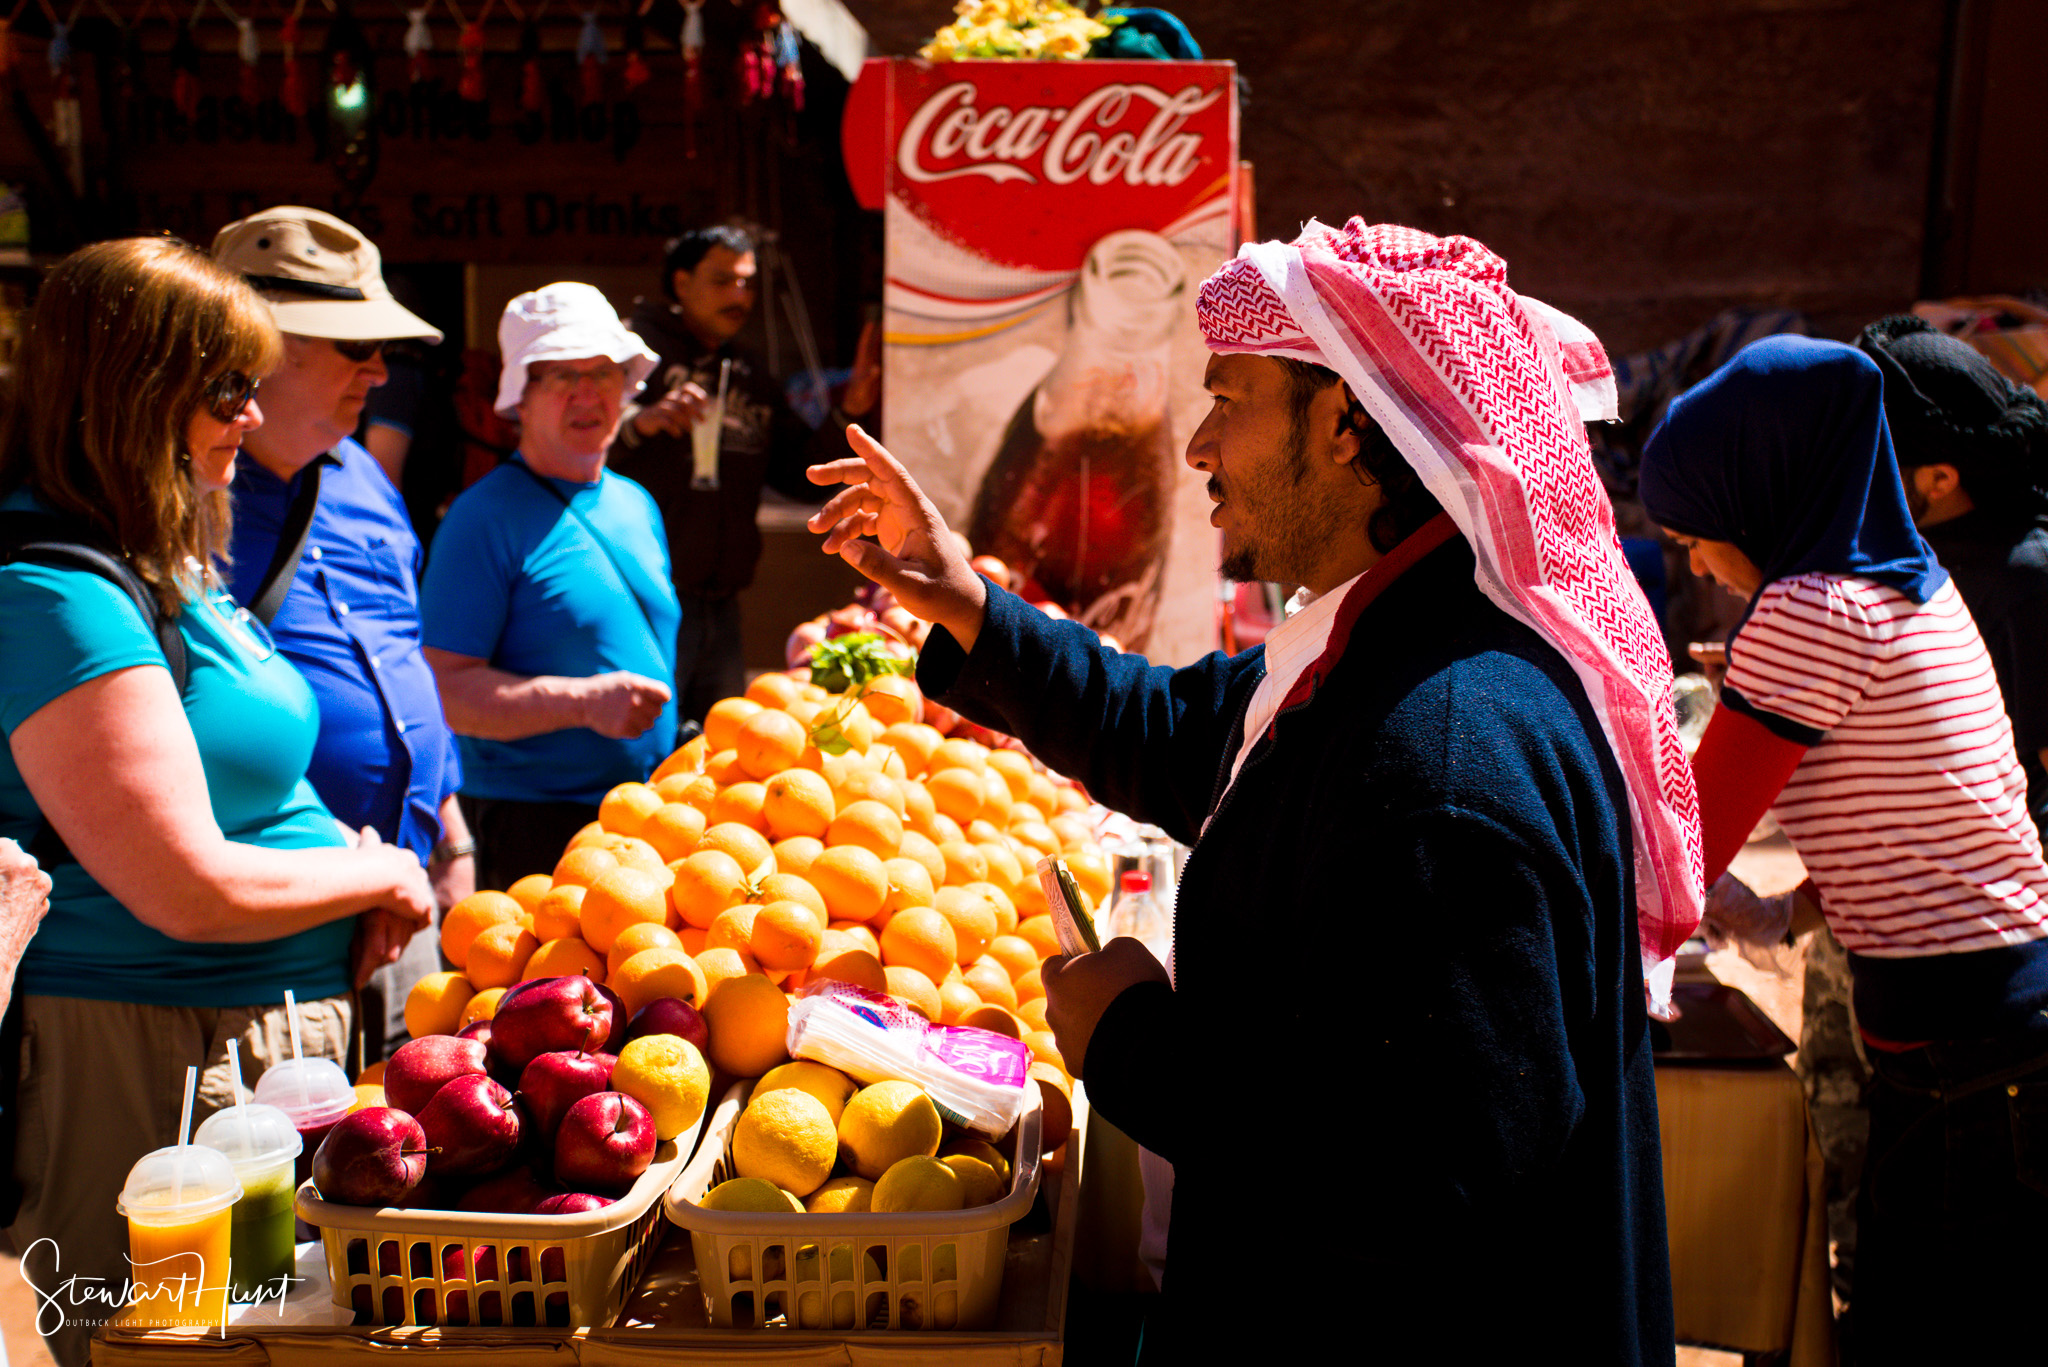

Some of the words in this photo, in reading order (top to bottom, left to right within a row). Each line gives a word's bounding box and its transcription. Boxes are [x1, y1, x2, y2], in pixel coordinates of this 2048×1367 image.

[897, 82, 1225, 186] Coca-Cola
[410, 192, 503, 239] Soft
[526, 192, 681, 237] Drinks
